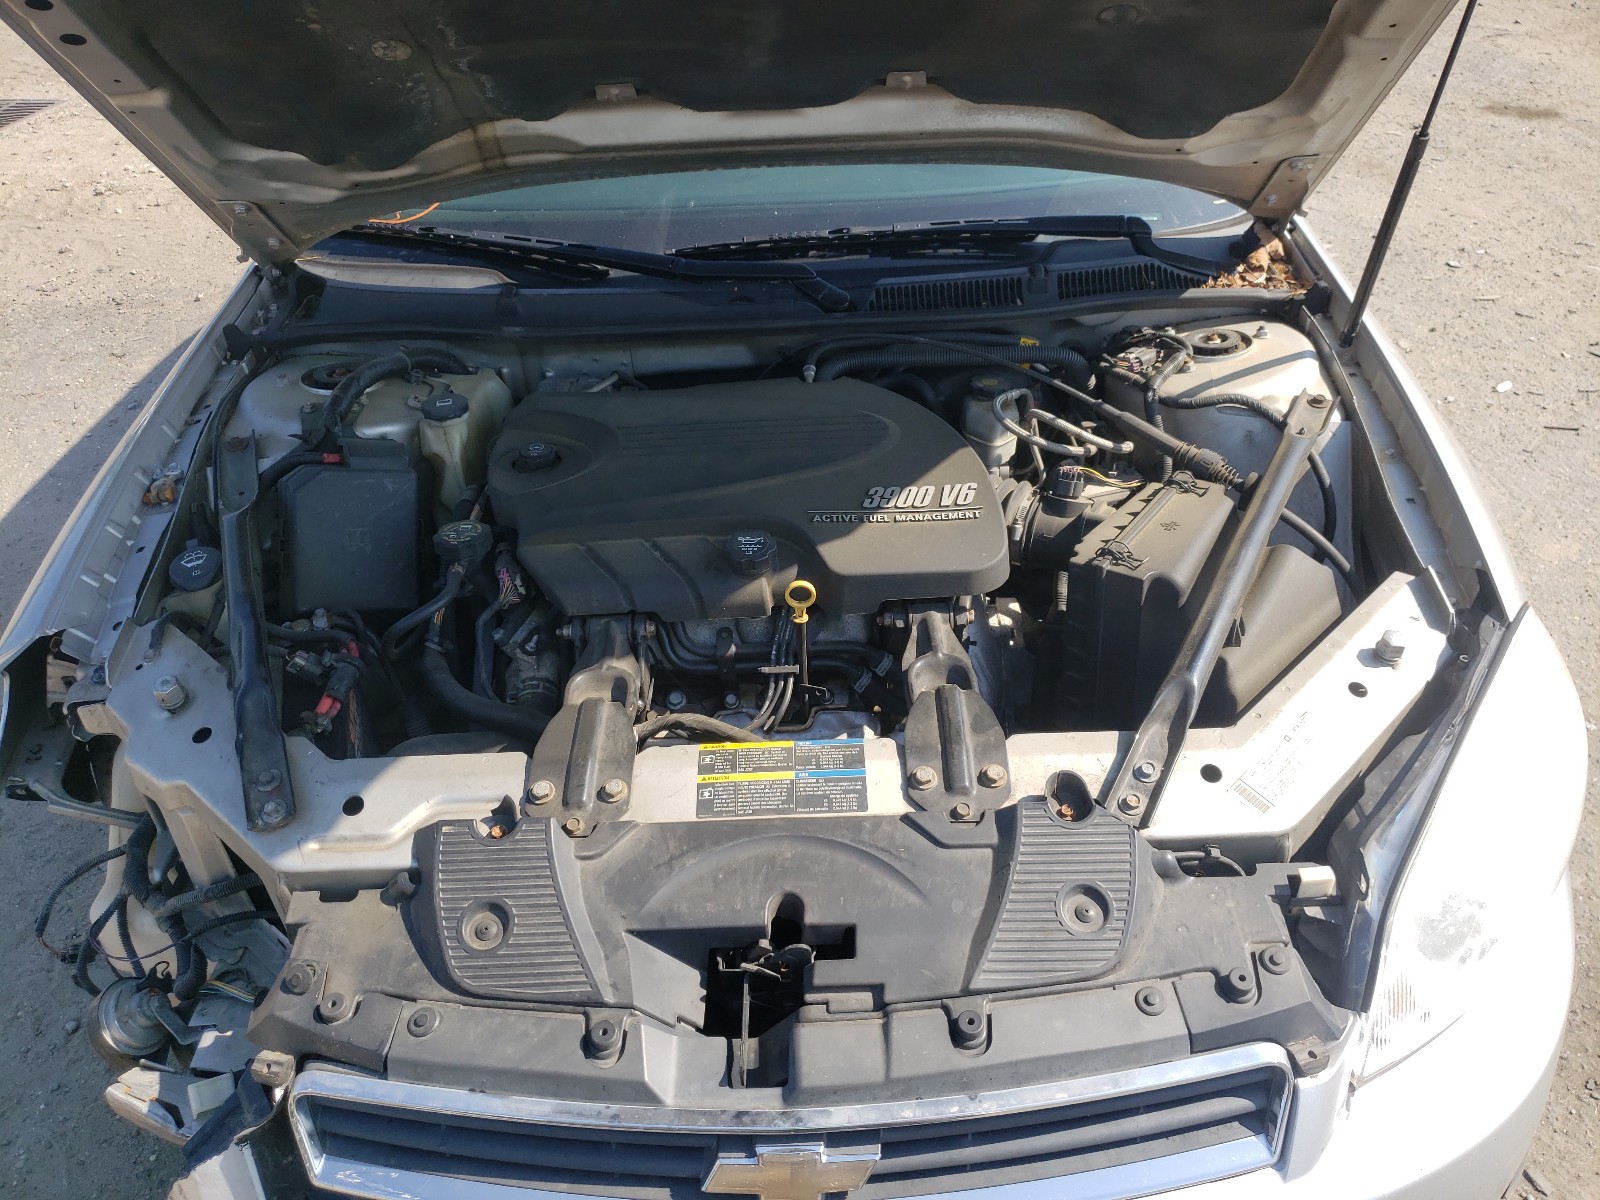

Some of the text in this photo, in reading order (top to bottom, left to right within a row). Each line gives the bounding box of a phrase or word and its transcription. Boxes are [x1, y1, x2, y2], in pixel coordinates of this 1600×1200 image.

[862, 482, 978, 509] 3900 V6
[812, 510, 982, 523] ACTIVE FUEL MANAGEMENT
